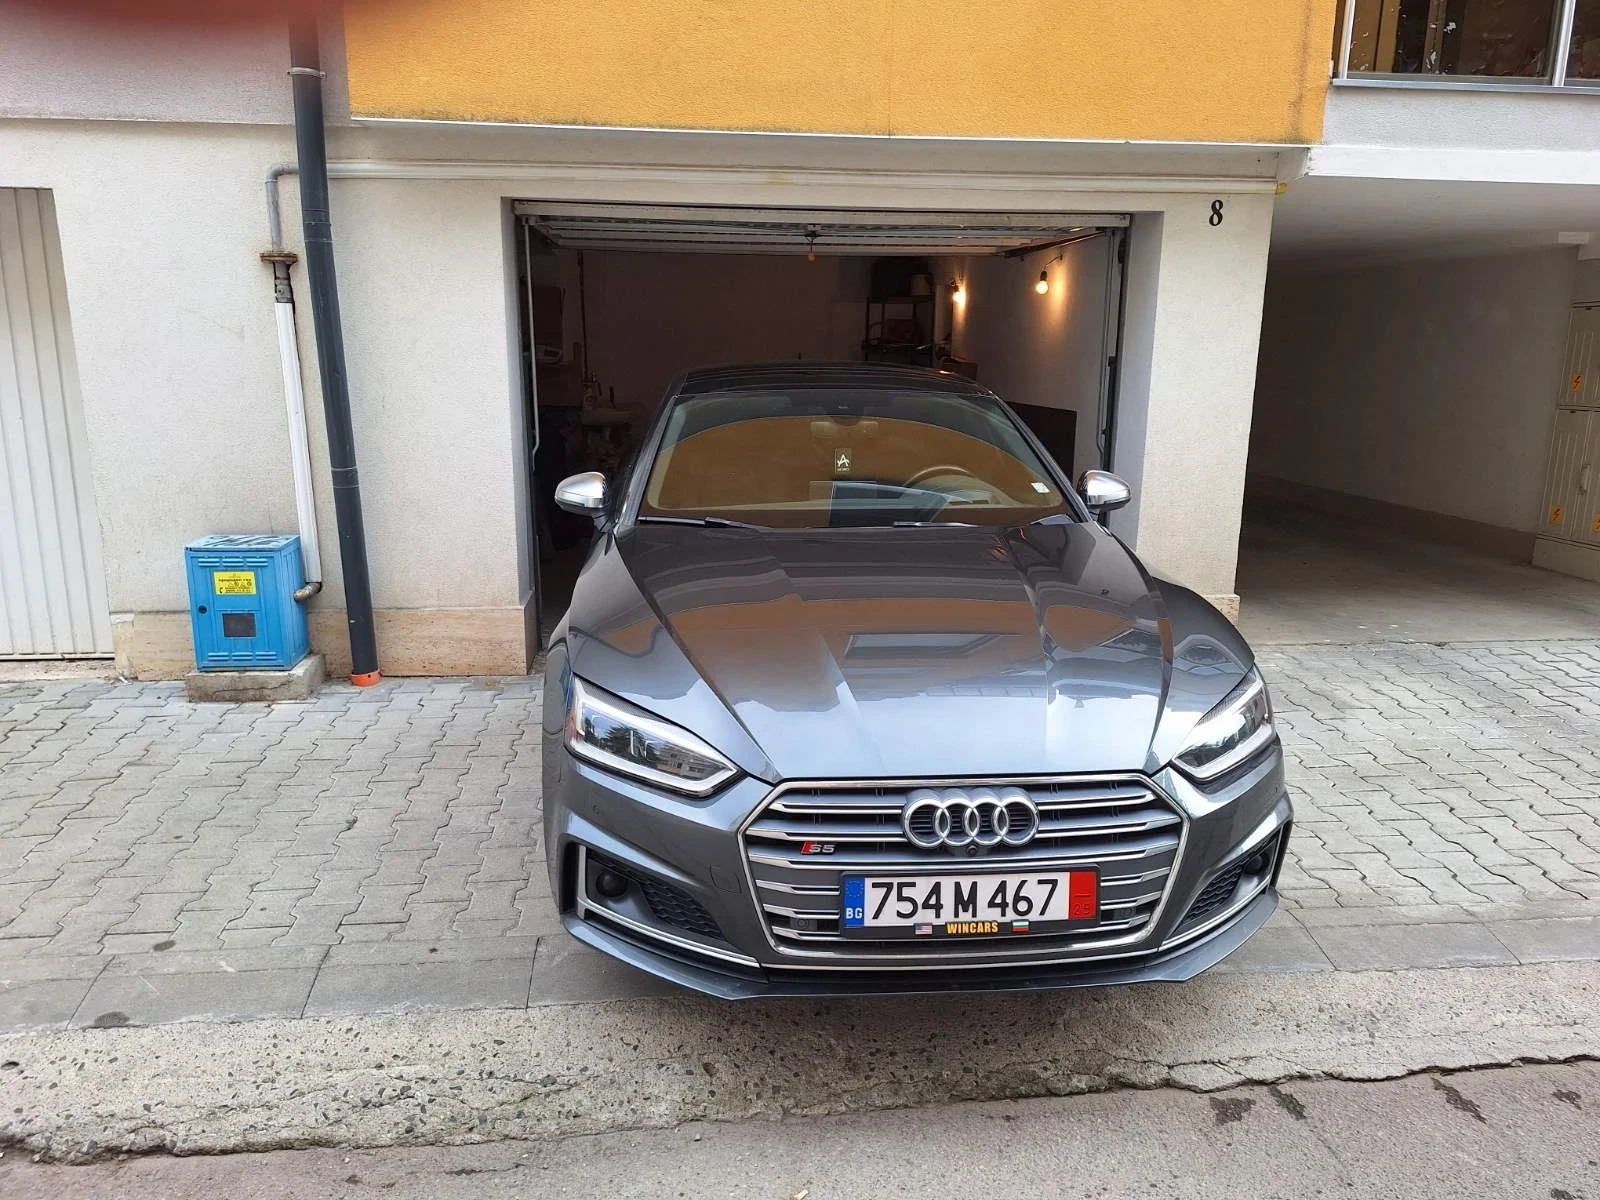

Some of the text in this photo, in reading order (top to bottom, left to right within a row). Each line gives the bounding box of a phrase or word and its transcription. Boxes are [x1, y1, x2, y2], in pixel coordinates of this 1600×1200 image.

[1209, 200, 1223, 226] 8
[810, 844, 836, 853] S5
[871, 879, 1059, 919] 754 M 467
[845, 907, 863, 919] BG
[946, 922, 999, 935] WINCARS
